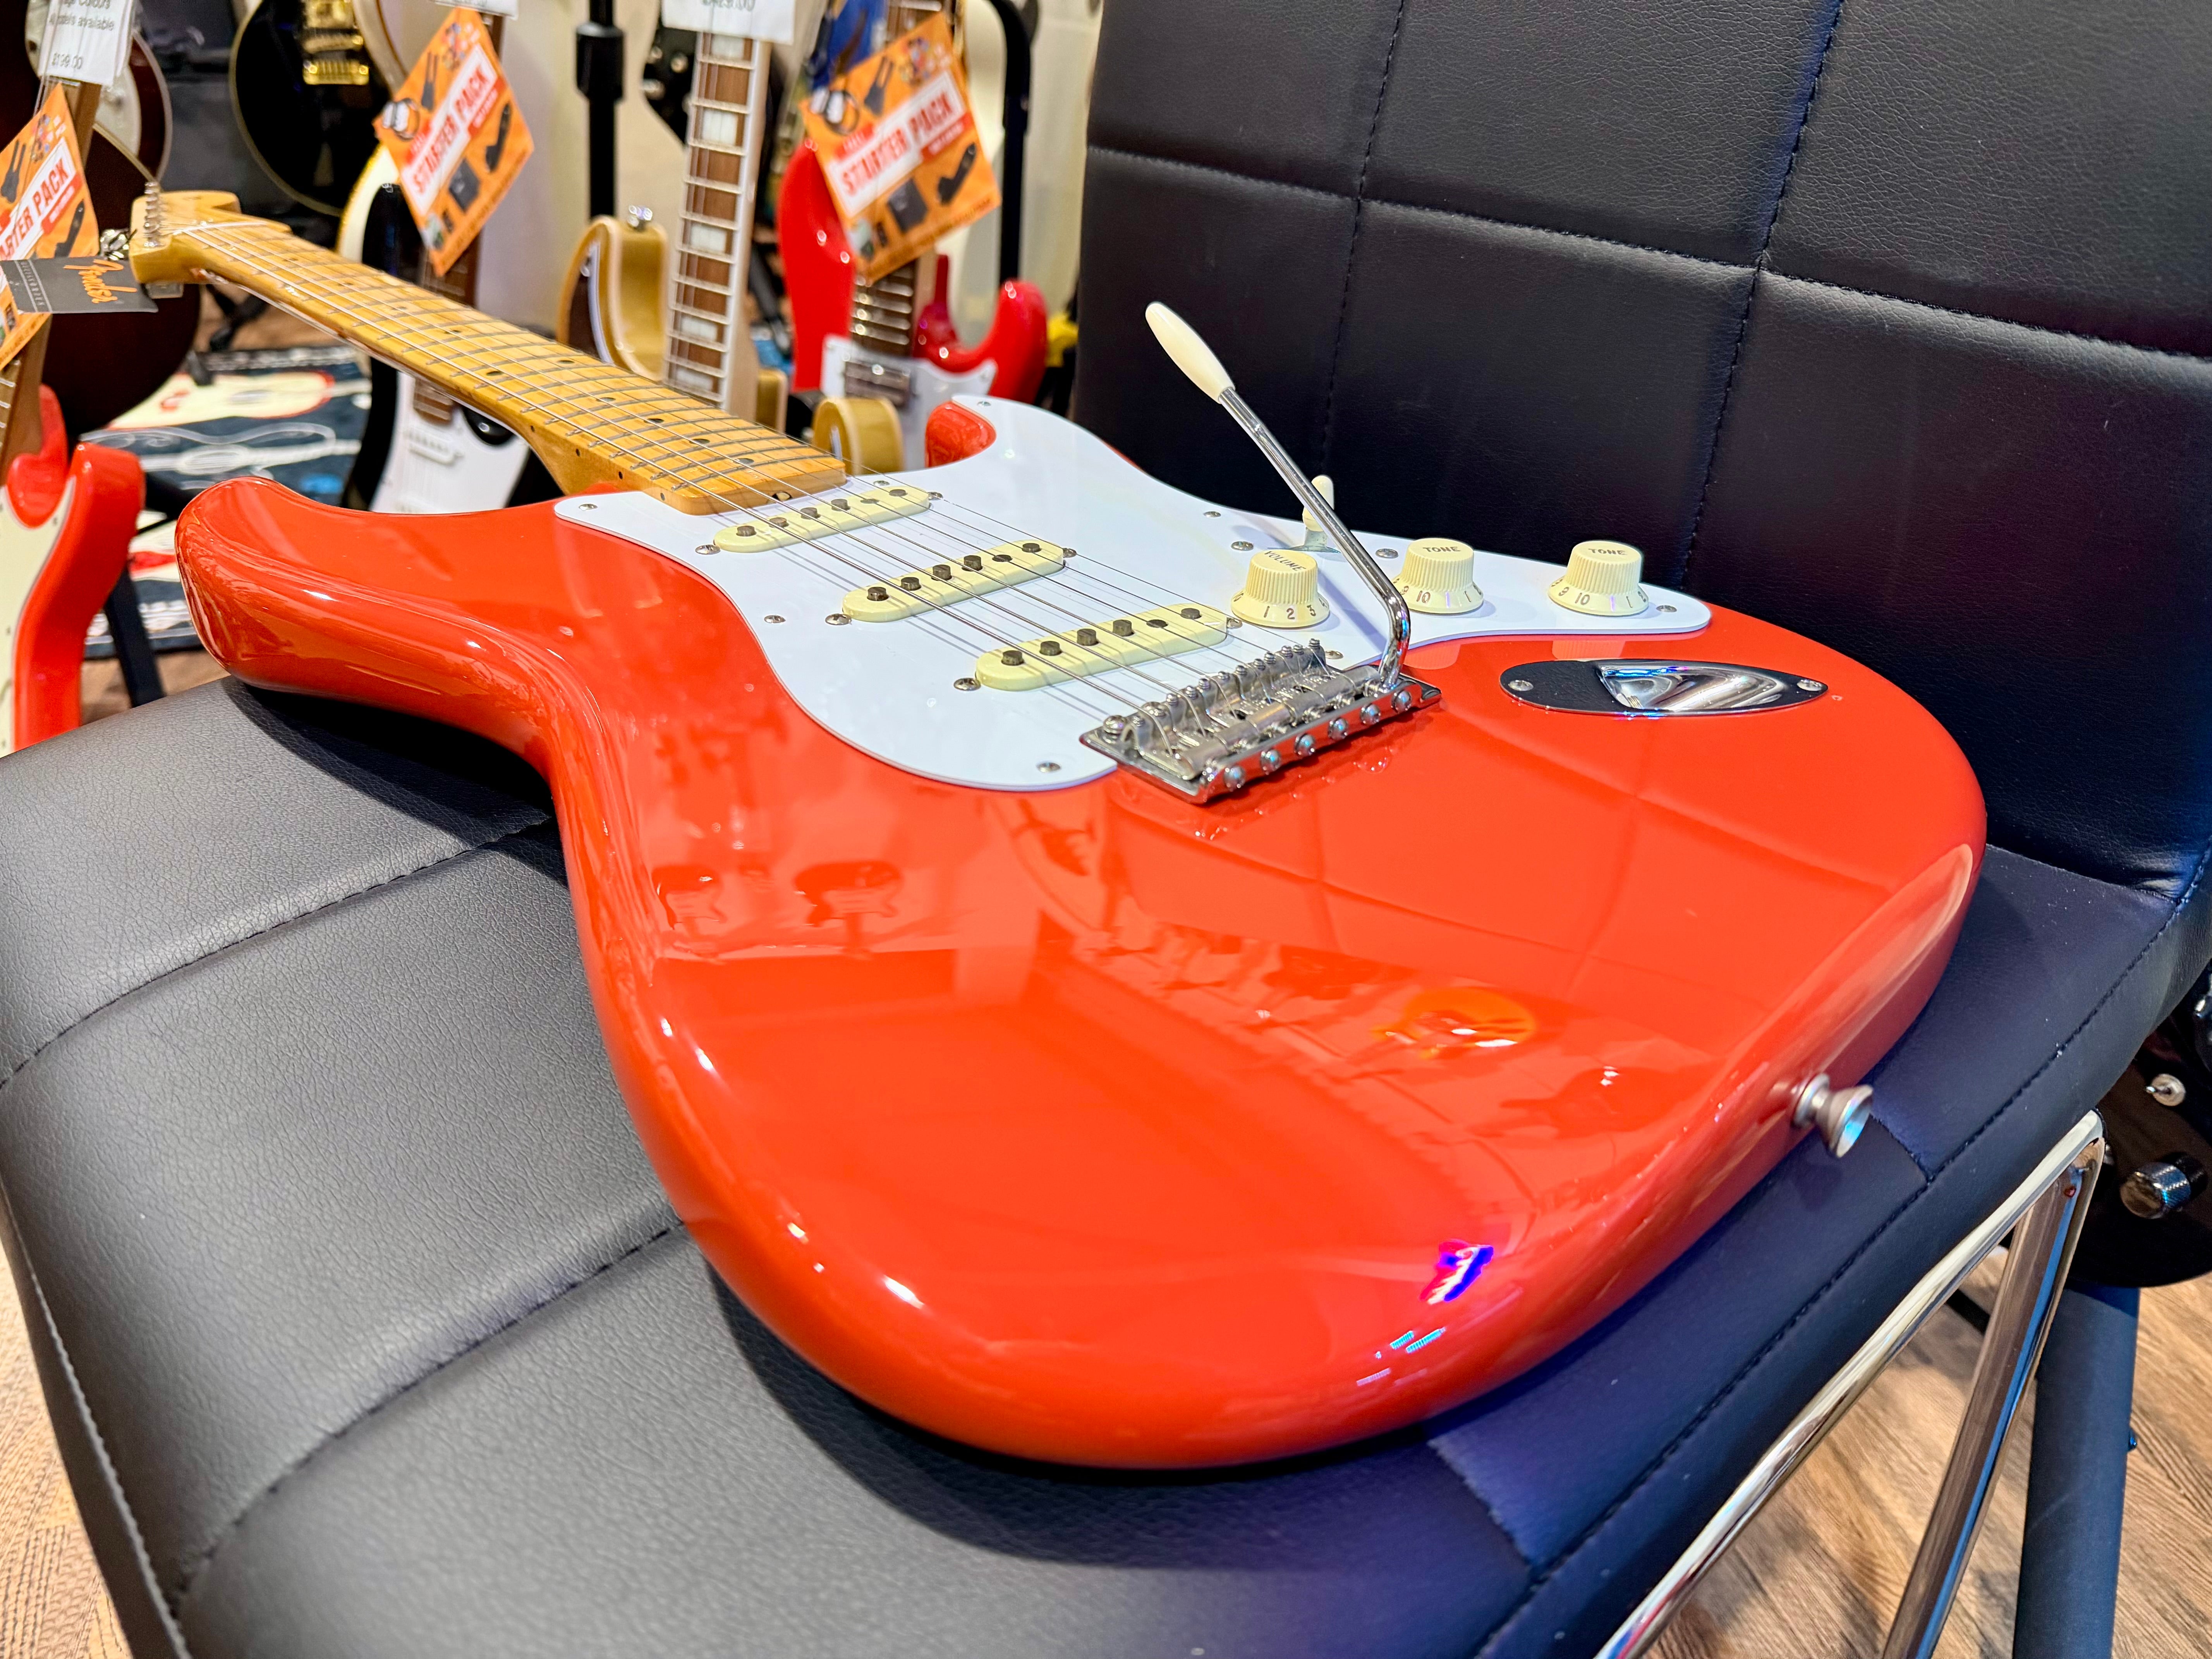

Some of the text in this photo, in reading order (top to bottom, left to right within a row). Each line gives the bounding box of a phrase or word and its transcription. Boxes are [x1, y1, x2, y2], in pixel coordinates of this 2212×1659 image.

[77, 17, 115, 31] available
[413, 114, 460, 193] STARTER
[455, 65, 488, 121] PACK
[842, 128, 908, 195] STARTER
[908, 91, 953, 143] PACK
[32, 158, 70, 216] PACK
[63, 259, 137, 304] Fender
[1264, 551, 1307, 572] VOLUME
[1416, 590, 1431, 603] 10
[1575, 592, 1590, 606] 10
[1264, 605, 1270, 618] 1
[1286, 608, 1295, 620] 2
[1306, 605, 1316, 617] 3
